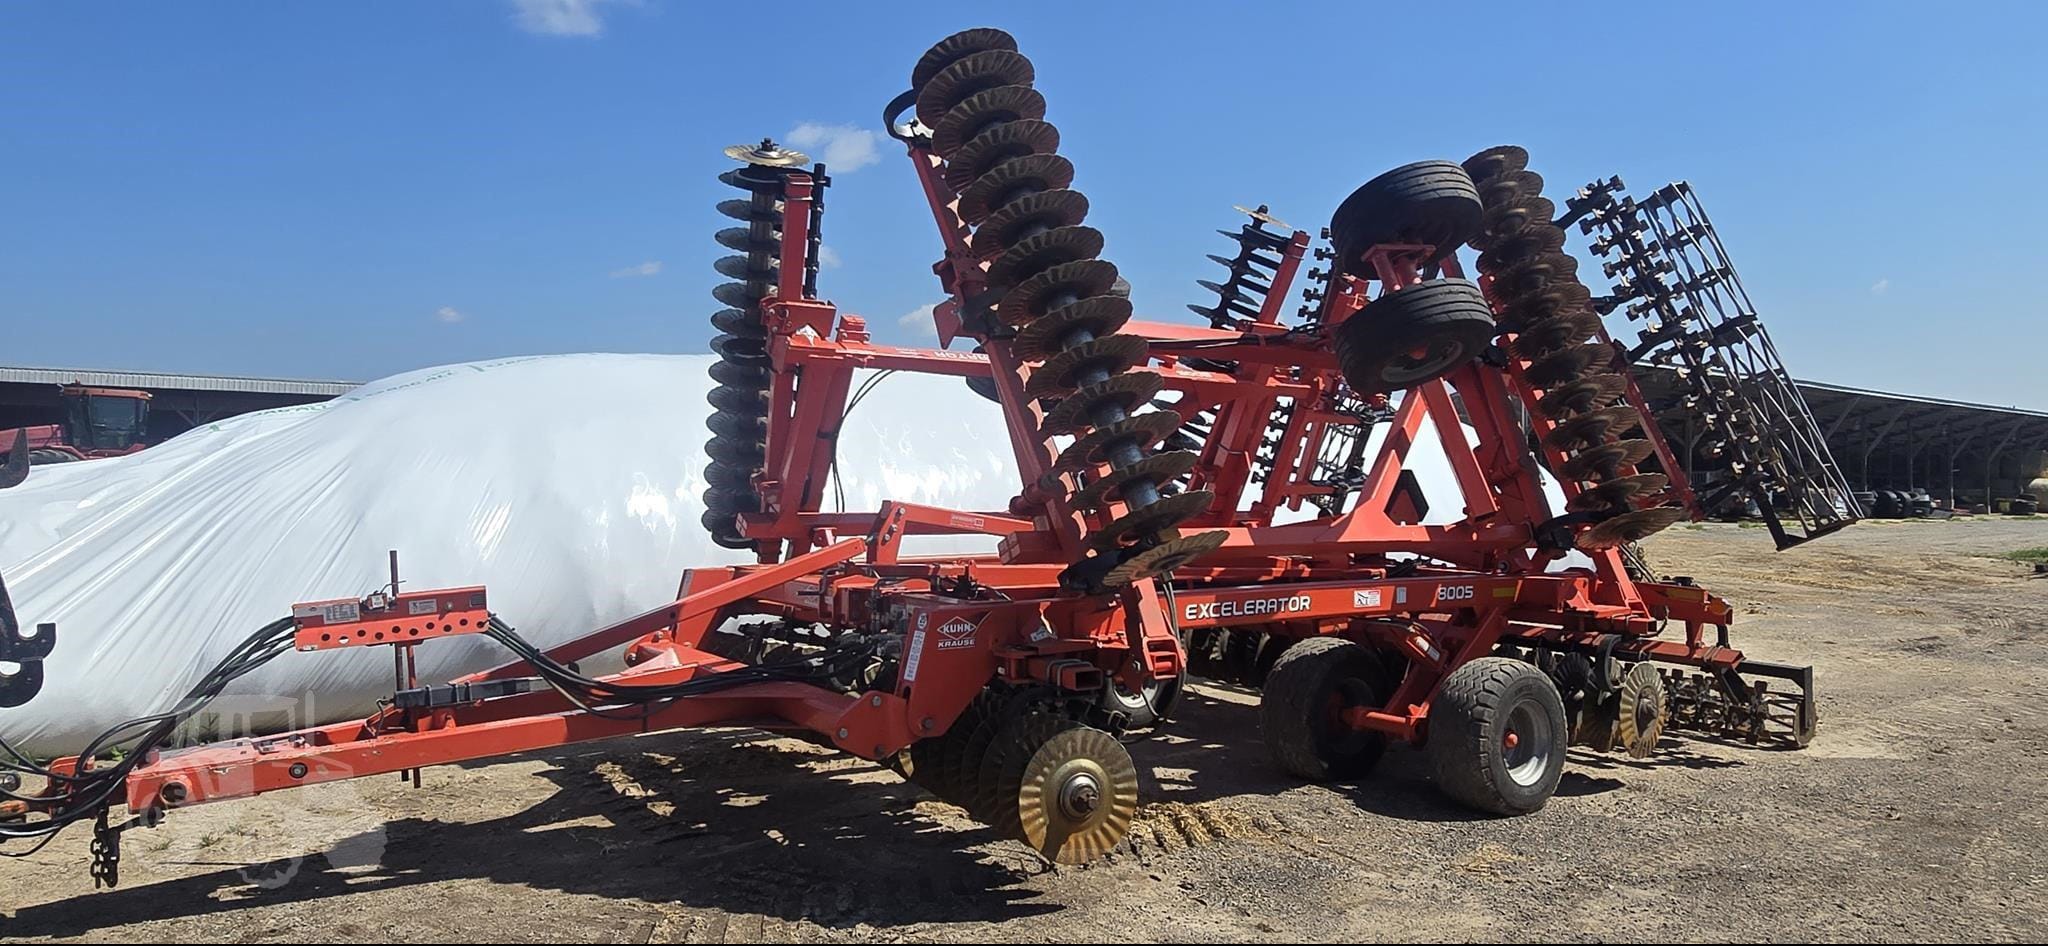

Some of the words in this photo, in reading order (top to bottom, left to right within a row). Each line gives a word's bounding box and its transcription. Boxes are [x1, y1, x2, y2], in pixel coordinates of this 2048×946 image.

[1438, 586, 1473, 600] 8005
[1185, 596, 1311, 619] EXCELERATOR
[943, 623, 971, 634] KUHN
[937, 639, 975, 648] KRAUSE
